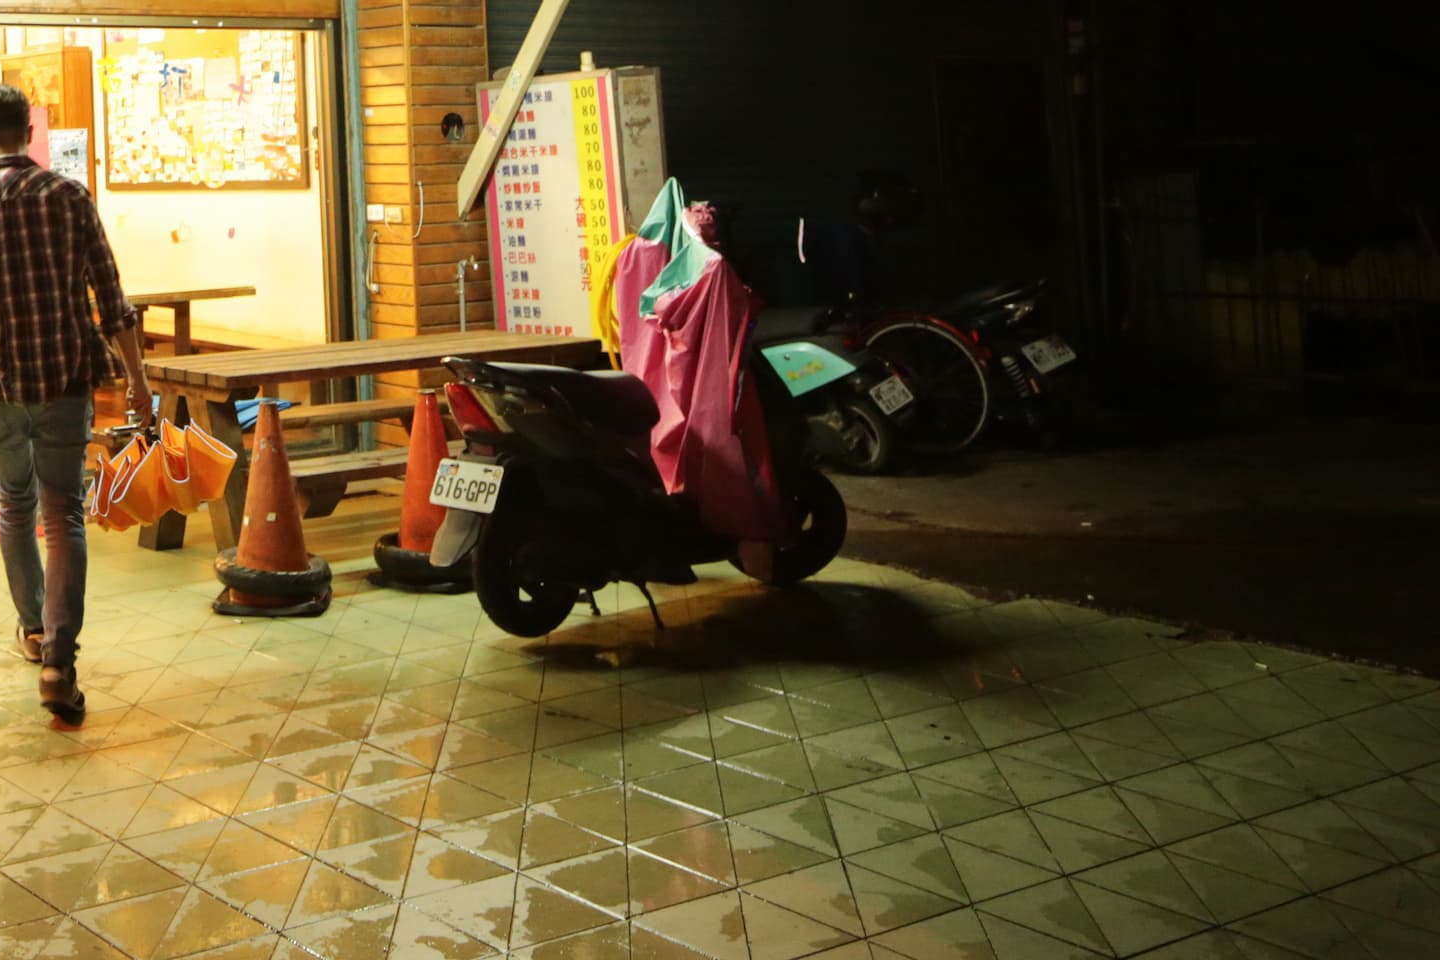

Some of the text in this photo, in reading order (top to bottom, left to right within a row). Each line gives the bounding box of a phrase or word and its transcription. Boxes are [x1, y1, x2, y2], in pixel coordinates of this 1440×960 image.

[574, 86, 595, 100] 100
[581, 103, 597, 117] 80
[583, 122, 598, 136] 80
[585, 140, 600, 154] 70
[586, 159, 602, 173] 80
[588, 177, 604, 191] 80
